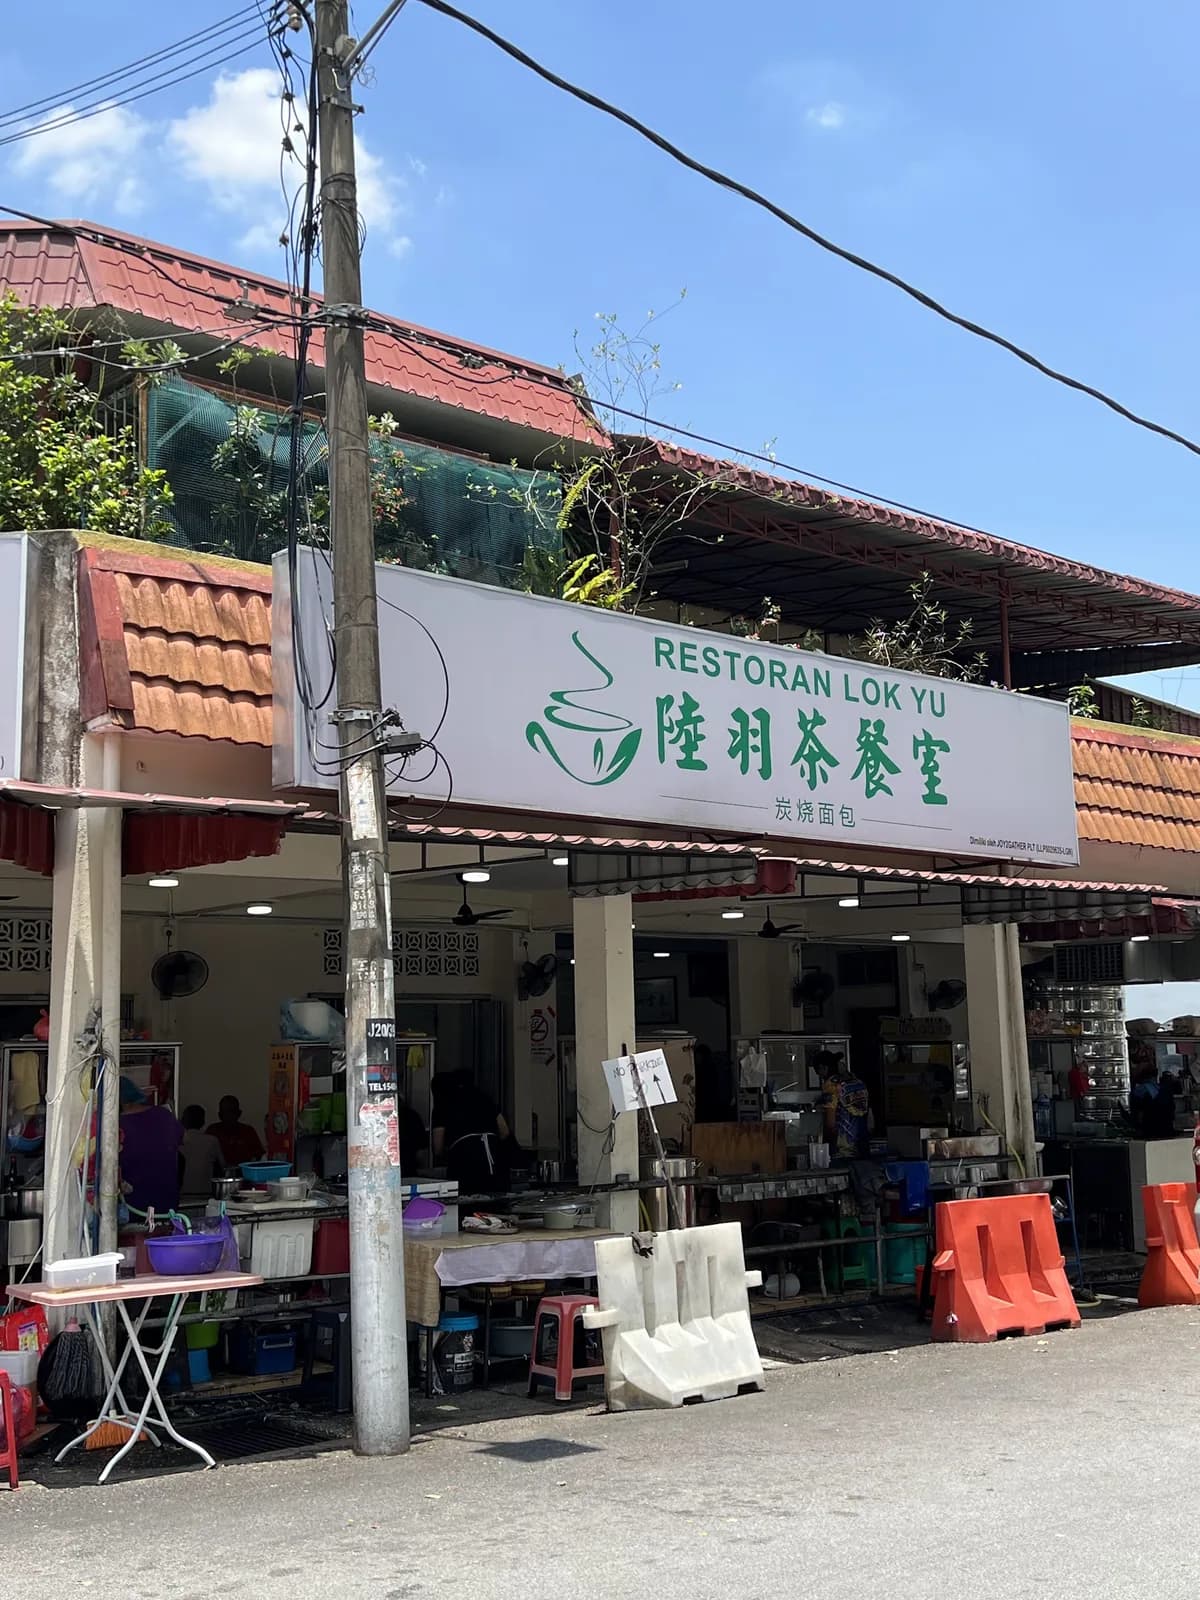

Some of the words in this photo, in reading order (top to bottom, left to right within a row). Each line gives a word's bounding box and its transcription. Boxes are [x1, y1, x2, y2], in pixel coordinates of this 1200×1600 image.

[654, 636, 833, 697] RESTORAN
[843, 673, 902, 711] LOK
[910, 687, 946, 718] YU
[655, 690, 951, 806] 陸羽茶餐室
[775, 796, 856, 828] 炭烧面包
[383, 1047, 389, 1061] 1
[612, 1065, 626, 1079] NO
